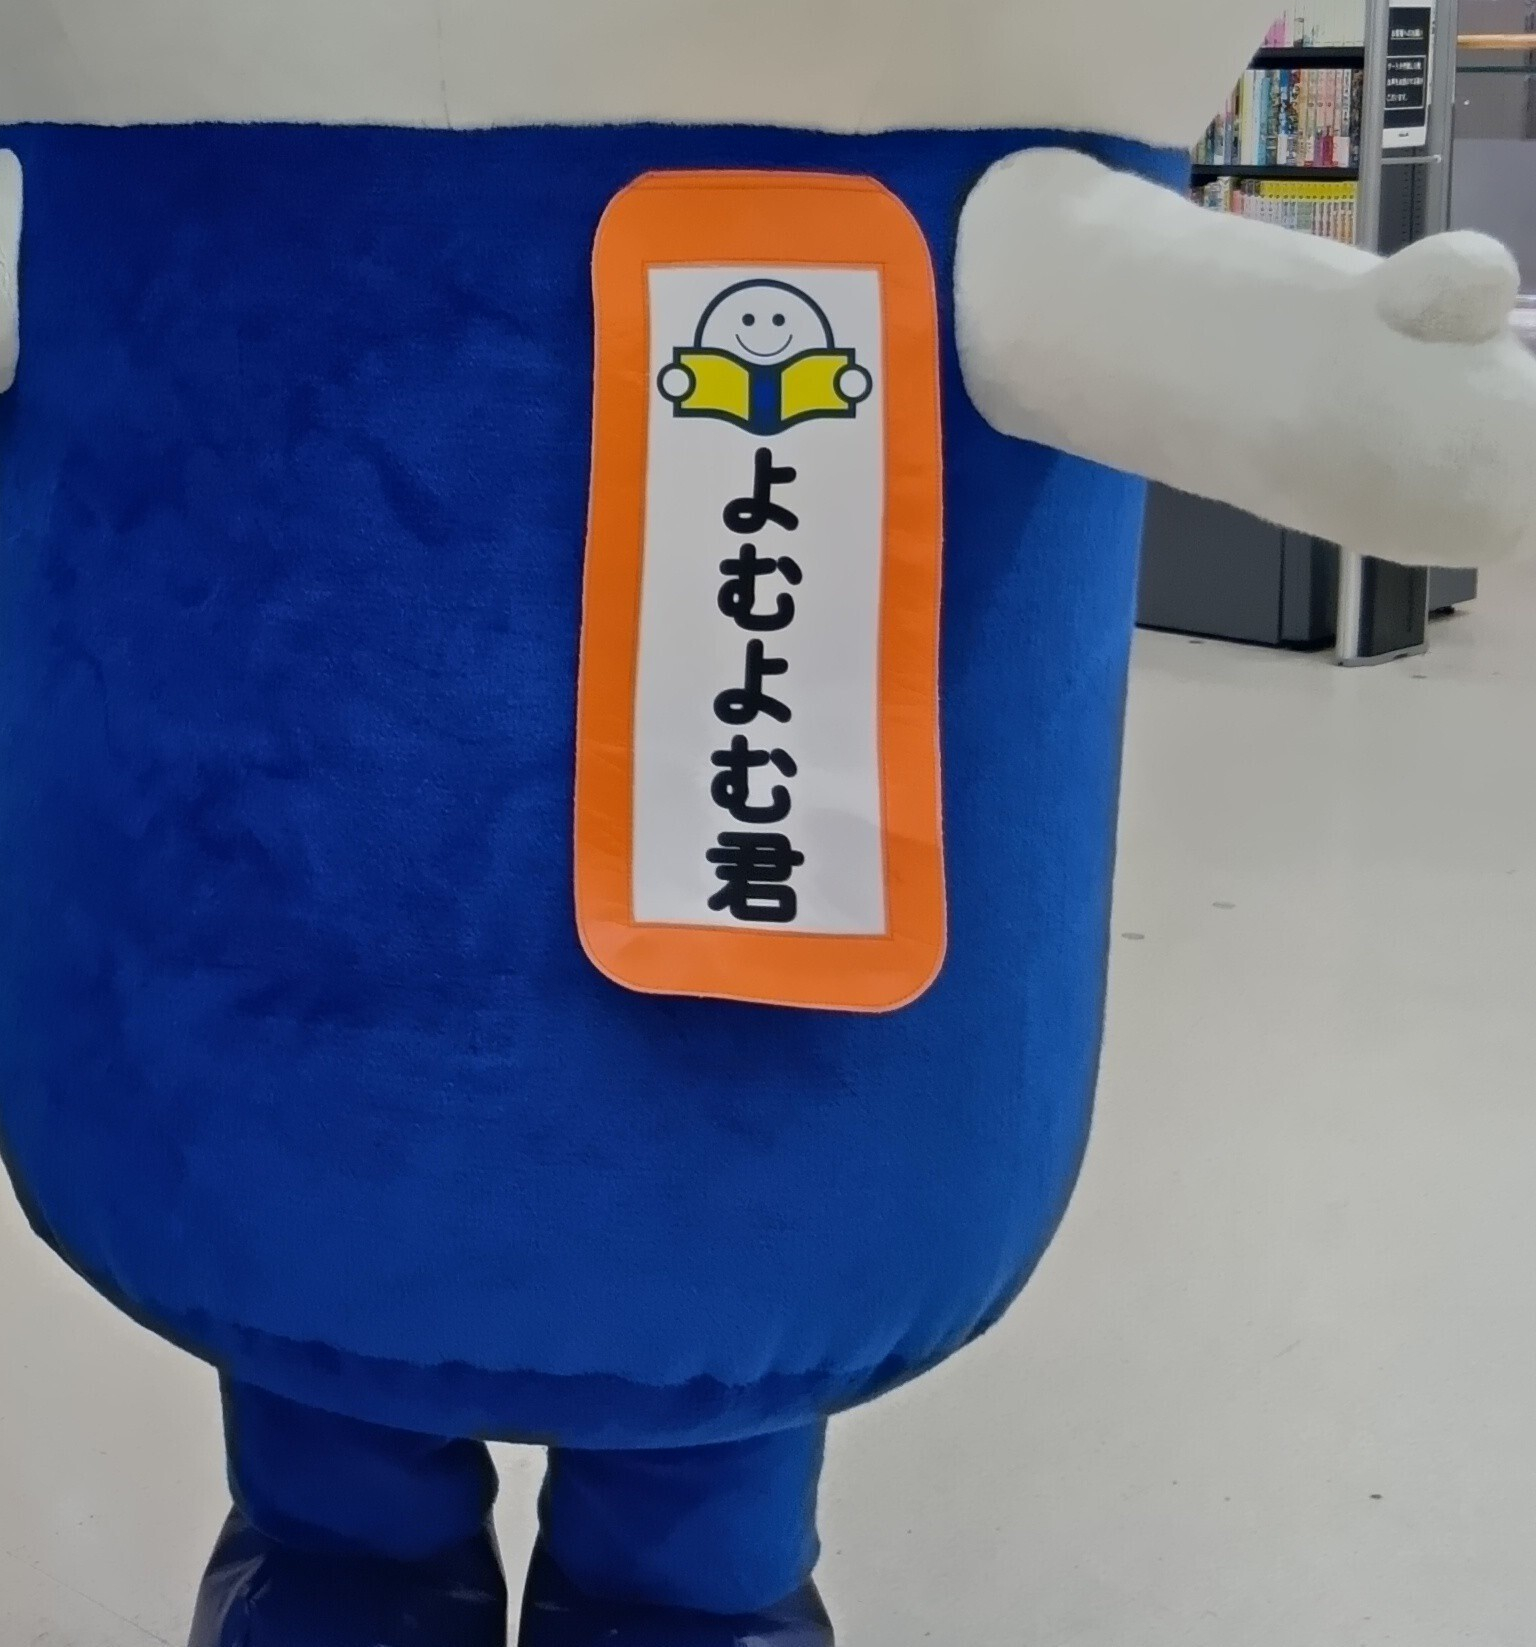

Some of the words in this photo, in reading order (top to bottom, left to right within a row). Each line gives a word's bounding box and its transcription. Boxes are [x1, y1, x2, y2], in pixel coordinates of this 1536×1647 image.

[705, 446, 806, 922] よむよむ君
